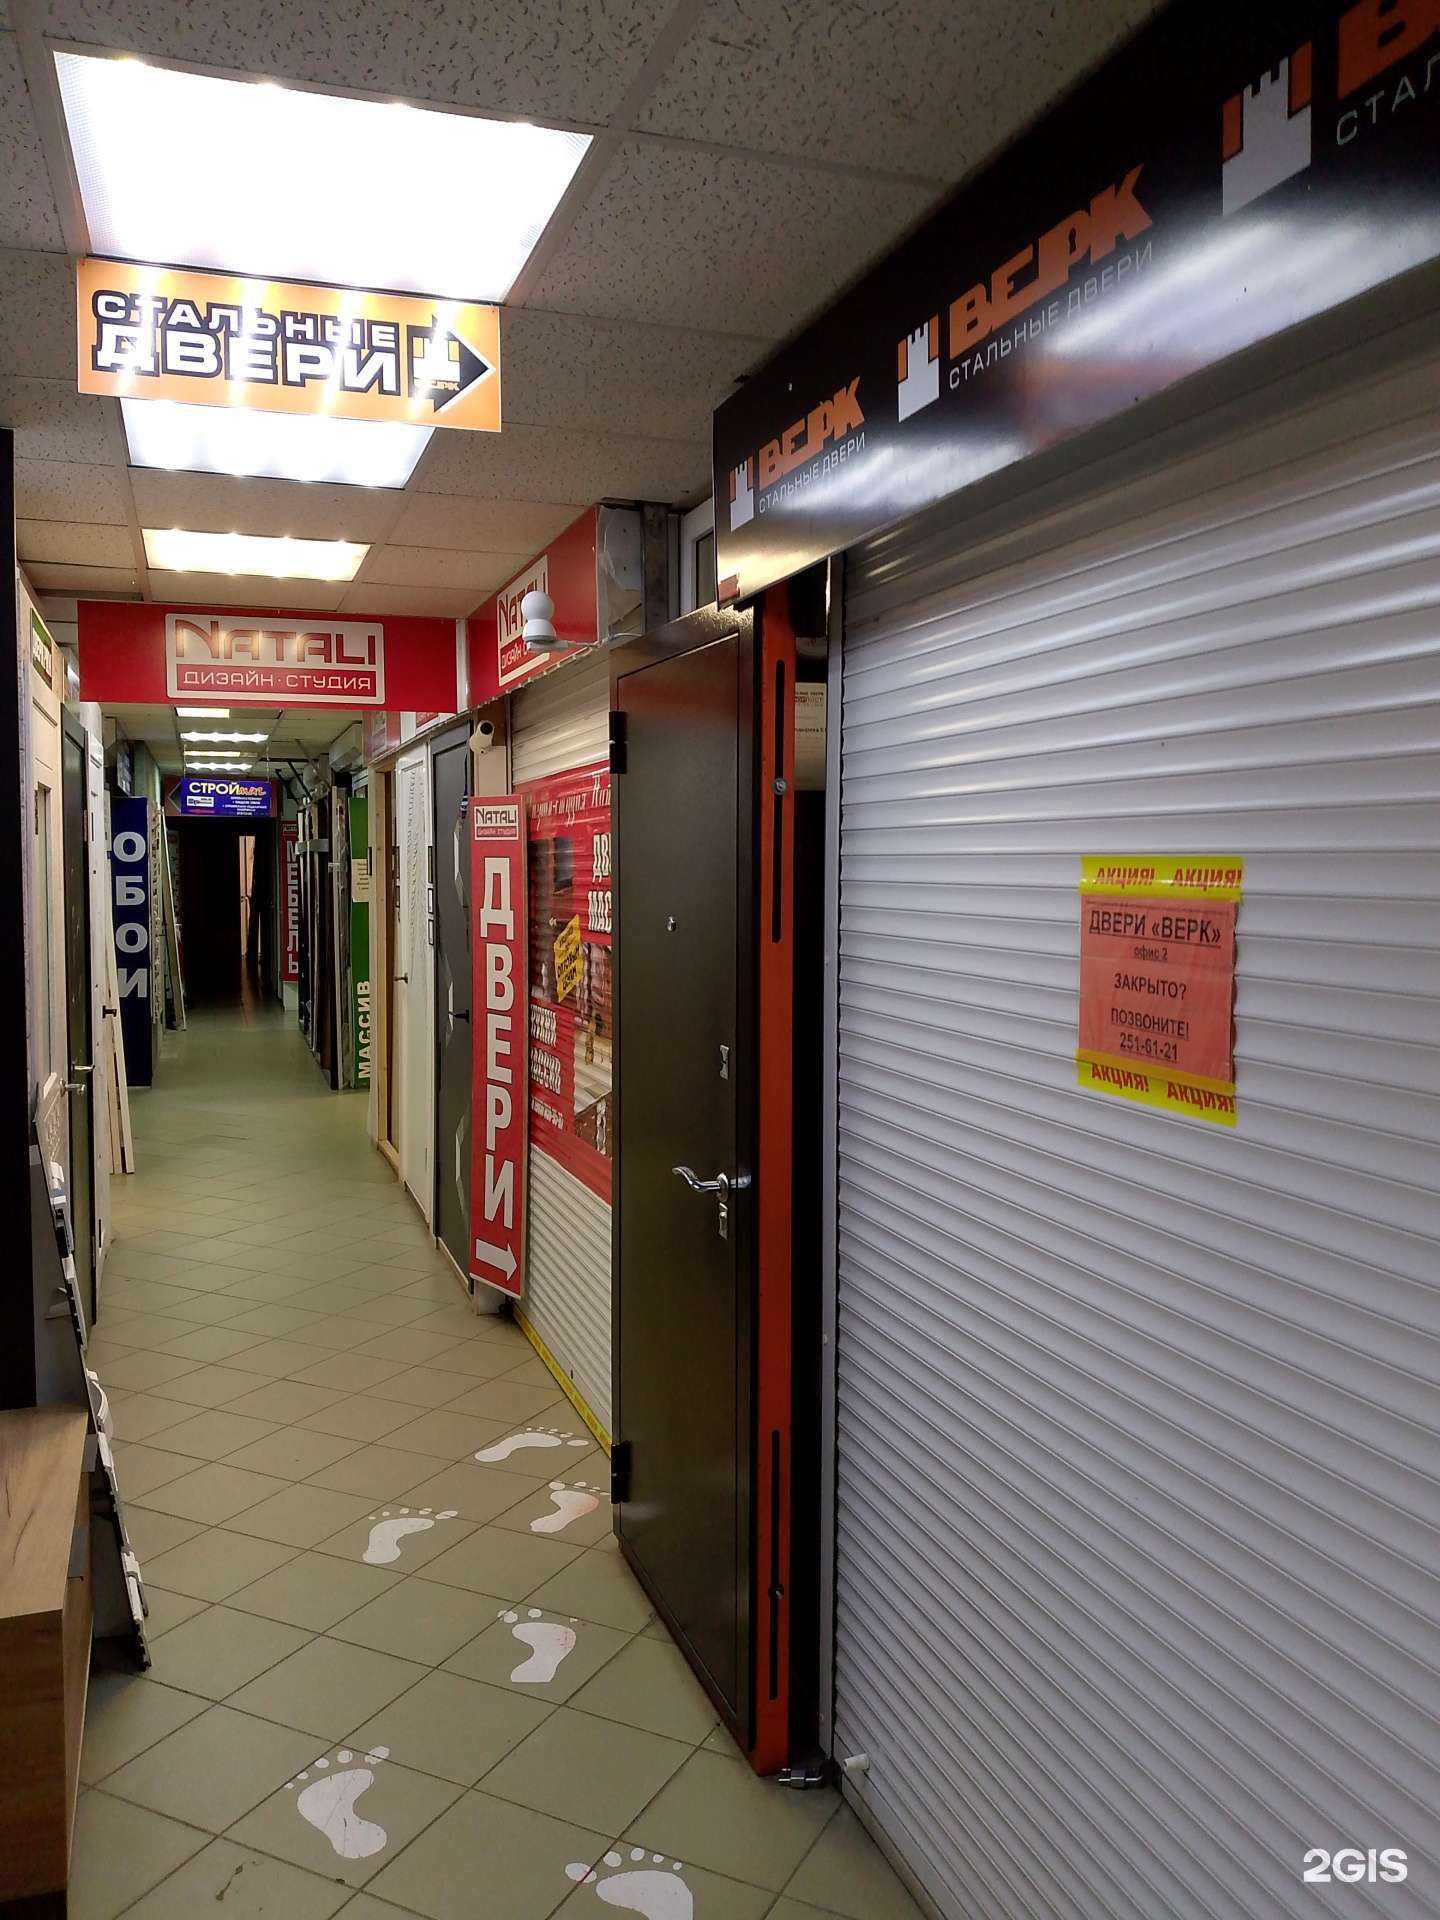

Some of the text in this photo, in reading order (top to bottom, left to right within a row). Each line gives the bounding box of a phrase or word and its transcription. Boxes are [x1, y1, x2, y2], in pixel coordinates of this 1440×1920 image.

[949, 163, 1153, 360] ВЕРК
[92, 289, 400, 350] СТАЛЬНЫЕ
[949, 241, 1153, 389] СТАЛЬНЫЕ ДВЕРИ
[91, 322, 400, 396] ДВЕРИ
[758, 375, 865, 491] ВЕРК
[758, 431, 866, 514] СТАЛЬНЫЕ ДВЕРИ
[183, 670, 371, 690] ДИЗАЙН СТУДИЯ
[113, 831, 148, 998] ОБОИ
[286, 840, 300, 974] МЕБЕЛЬ
[1095, 867, 1242, 891] АКЦИЯ! АКЦИЯ!
[1089, 910, 1221, 944] ДВЕРИ «ВЕРК»
[1114, 972, 1187, 1000] ЗАКРЫТО?
[357, 980, 371, 1079] МАССИВ
[479, 857, 515, 1230] ДВЕРИ
[1111, 1007, 1190, 1040] ПОЗВОНИТЕ!
[1120, 1032, 1178, 1061] 251-61-21
[1091, 1062, 1236, 1114] АКЦИЯ! АКЦИЯ!
